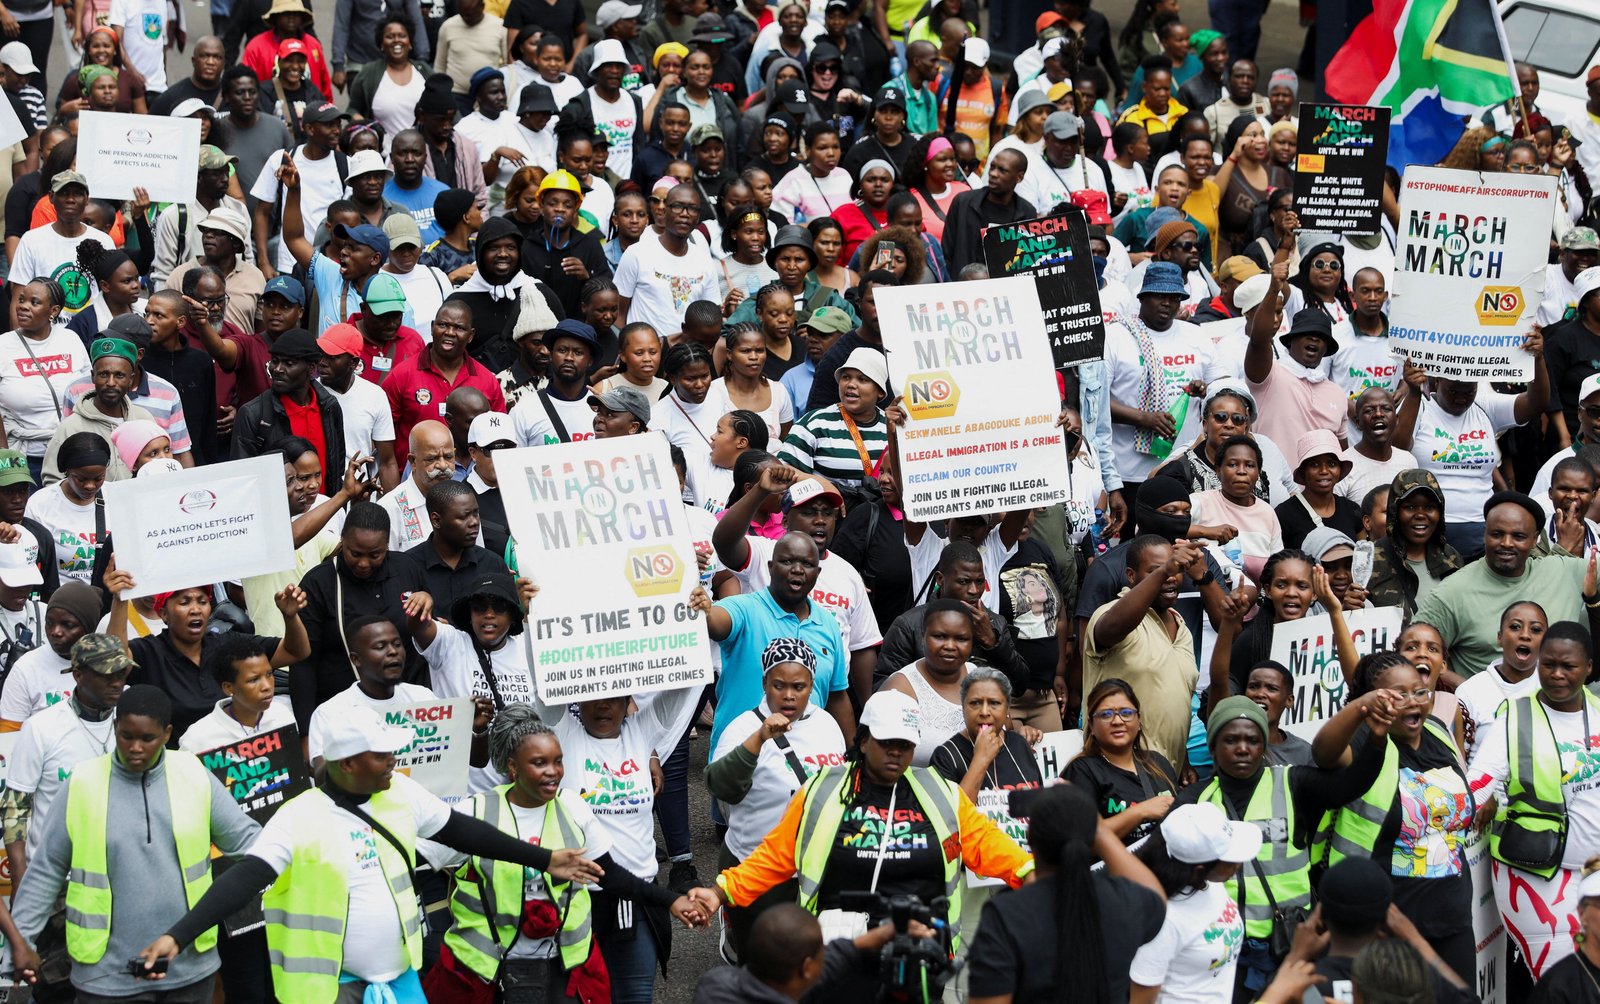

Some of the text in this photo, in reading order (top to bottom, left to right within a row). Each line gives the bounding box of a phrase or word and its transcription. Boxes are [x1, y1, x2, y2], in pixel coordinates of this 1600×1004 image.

[1315, 106, 1376, 121] MARCH
[1325, 120, 1362, 133] AND
[1313, 133, 1374, 147] MARCH
[1319, 147, 1364, 156] UNTIL WE WIN
[1315, 176, 1362, 186] BLACK, WHITE
[1407, 181, 1549, 199] #STOPHOMEAFFAIRSCORRUPTION
[1311, 187, 1329, 195] BLUE
[1342, 188, 1365, 196] GREEN
[1297, 197, 1379, 208] AN ILLEGAL IMMIGRANTS
[1302, 208, 1372, 218] REMAINS AN ILLEGAL
[998, 216, 1068, 243] MARCH
[1316, 219, 1358, 228] IMMIGRANTS
[1408, 210, 1507, 245] MARCH
[1016, 235, 1056, 255] AND
[1450, 238, 1462, 251] IN
[1005, 245, 1074, 272] MARCH
[1404, 244, 1503, 279] MARCH
[1037, 265, 1066, 278] WE WIN
[906, 296, 1014, 333] MARCH
[1060, 302, 1092, 316] POWER
[957, 325, 970, 338] IN
[1047, 324, 1059, 333] BE
[1061, 315, 1102, 331] TRUSTED
[1054, 331, 1094, 347] A CHECK
[1389, 326, 1529, 347] #DOIT4YOURCOUNTRY
[913, 331, 1023, 370] MARCH
[1391, 346, 1511, 365] JOIN US IN FIGHTING ILLEGAL
[1444, 366, 1523, 378] AND THEIR CRIMES
[905, 414, 1052, 440] SEKWANELE ABAGODUKE ABONI
[906, 435, 1061, 462] ILLEGAL IMMIGRATION IS A CRIME
[1432, 450, 1494, 464] MARCH
[524, 453, 662, 502] MARCH
[908, 462, 1018, 484] RECLAIM OUR COUNTRY
[911, 478, 1049, 503] JOIN US IN FIGHTING ILLEGAL
[590, 493, 608, 508] IN
[913, 490, 1066, 518] IMMIGRANTS AND THEIR CRIMES
[147, 513, 255, 538] AS A NATION LET'S FIGHT
[536, 499, 674, 550] MARCH
[156, 528, 248, 550] AGAINST ADDICTION!
[536, 602, 700, 640] IT'S TIME TO GO
[539, 631, 699, 666] #DOIT4THEIRFUTURE
[544, 656, 688, 683] JOIN US IN FIGHTING ILLEGAL
[1328, 667, 1339, 682] IN
[546, 669, 705, 699] IMMIGRANTS AND THEIR CRIMES
[386, 705, 453, 725] MARCH
[203, 732, 282, 770] MARCH
[411, 756, 424, 765] WE
[427, 754, 442, 763] WIN
[226, 757, 271, 786] AND
[595, 777, 635, 792] AND
[252, 797, 266, 810] WE
[267, 791, 284, 805] WIN
[580, 787, 650, 806] MARCH
[844, 806, 925, 822] MARCH
[860, 820, 912, 836] AND
[843, 833, 928, 850] MARCH
[857, 850, 879, 859] UNTIL
[895, 851, 911, 859] WIN
